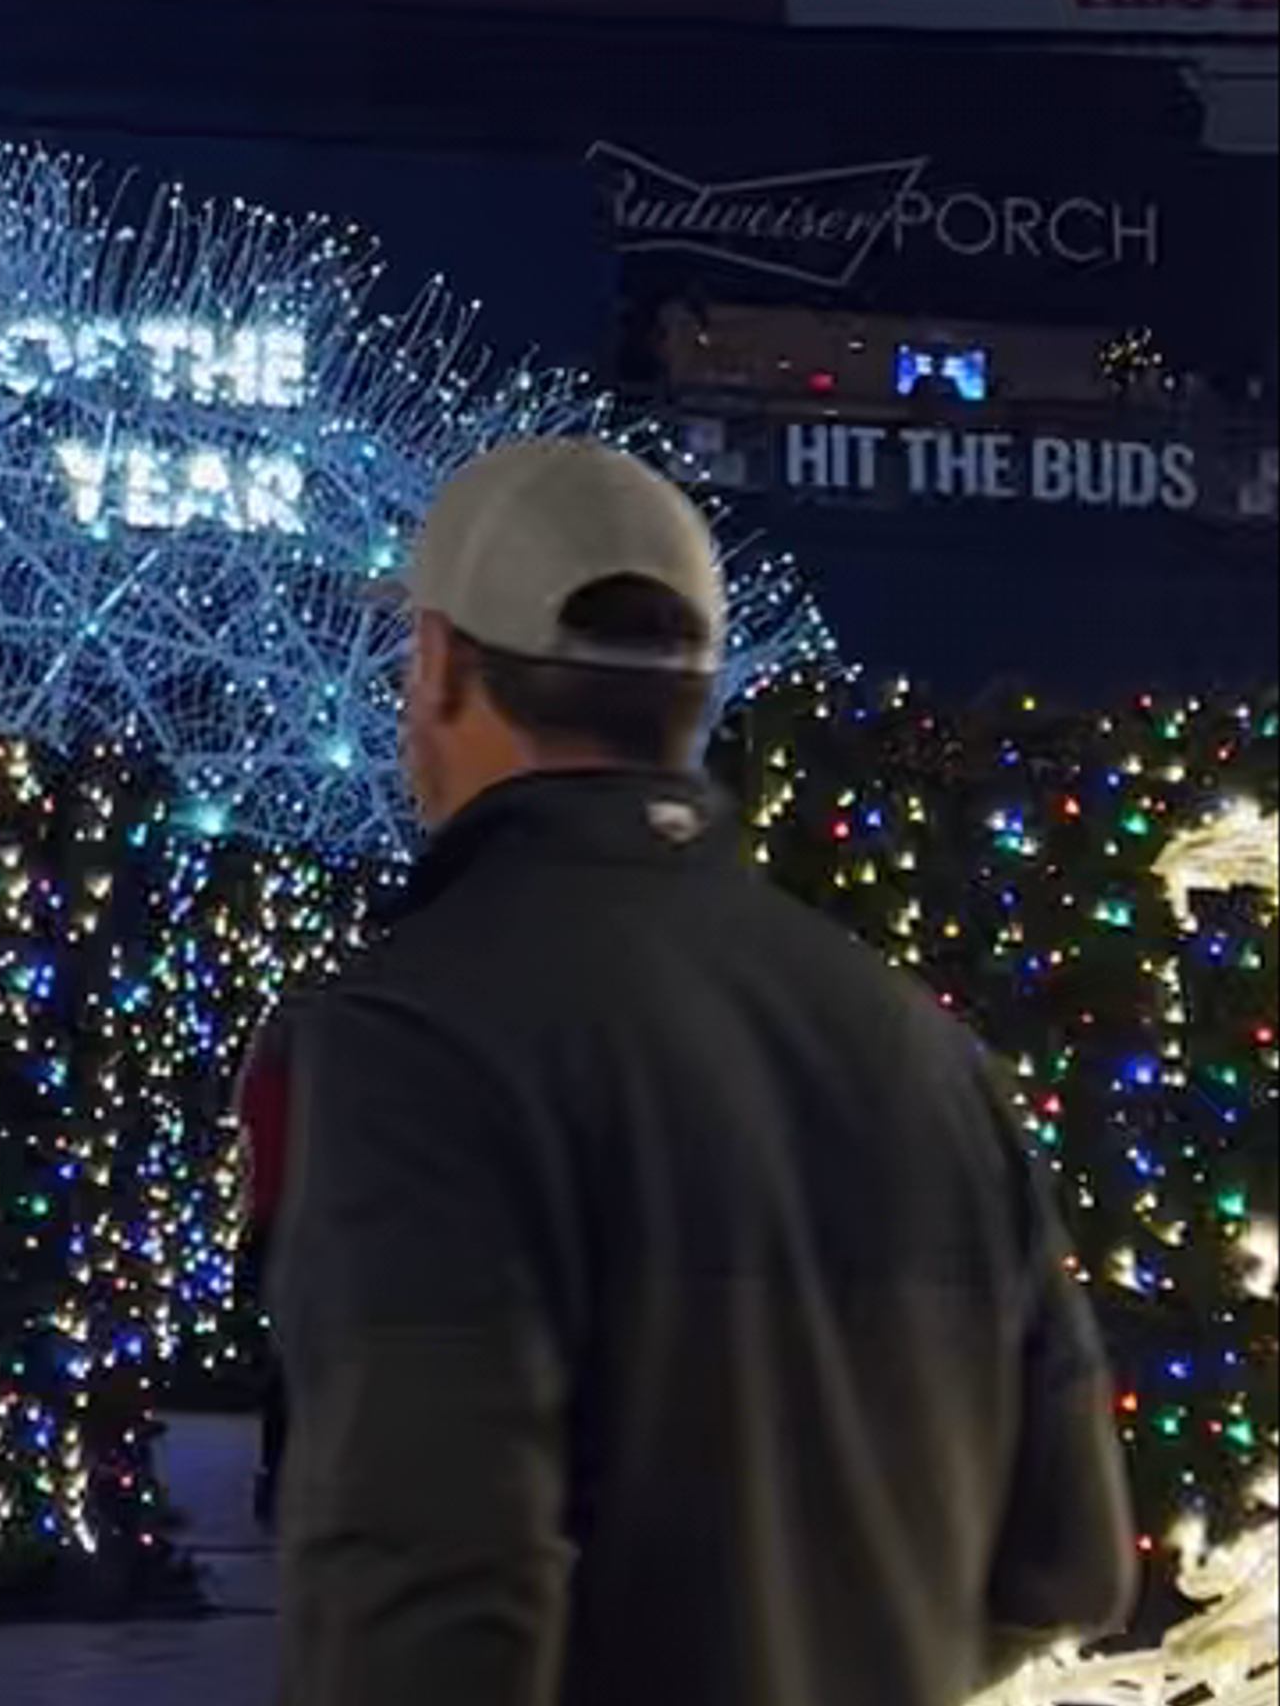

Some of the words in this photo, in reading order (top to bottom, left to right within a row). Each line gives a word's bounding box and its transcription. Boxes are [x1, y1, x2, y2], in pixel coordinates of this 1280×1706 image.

[892, 190, 1160, 268] PORCH
[140, 319, 306, 408] THE
[54, 439, 306, 534] YEAR
[786, 422, 886, 488] HIT
[899, 430, 1017, 501] THE
[1031, 437, 1198, 511] BUDS
